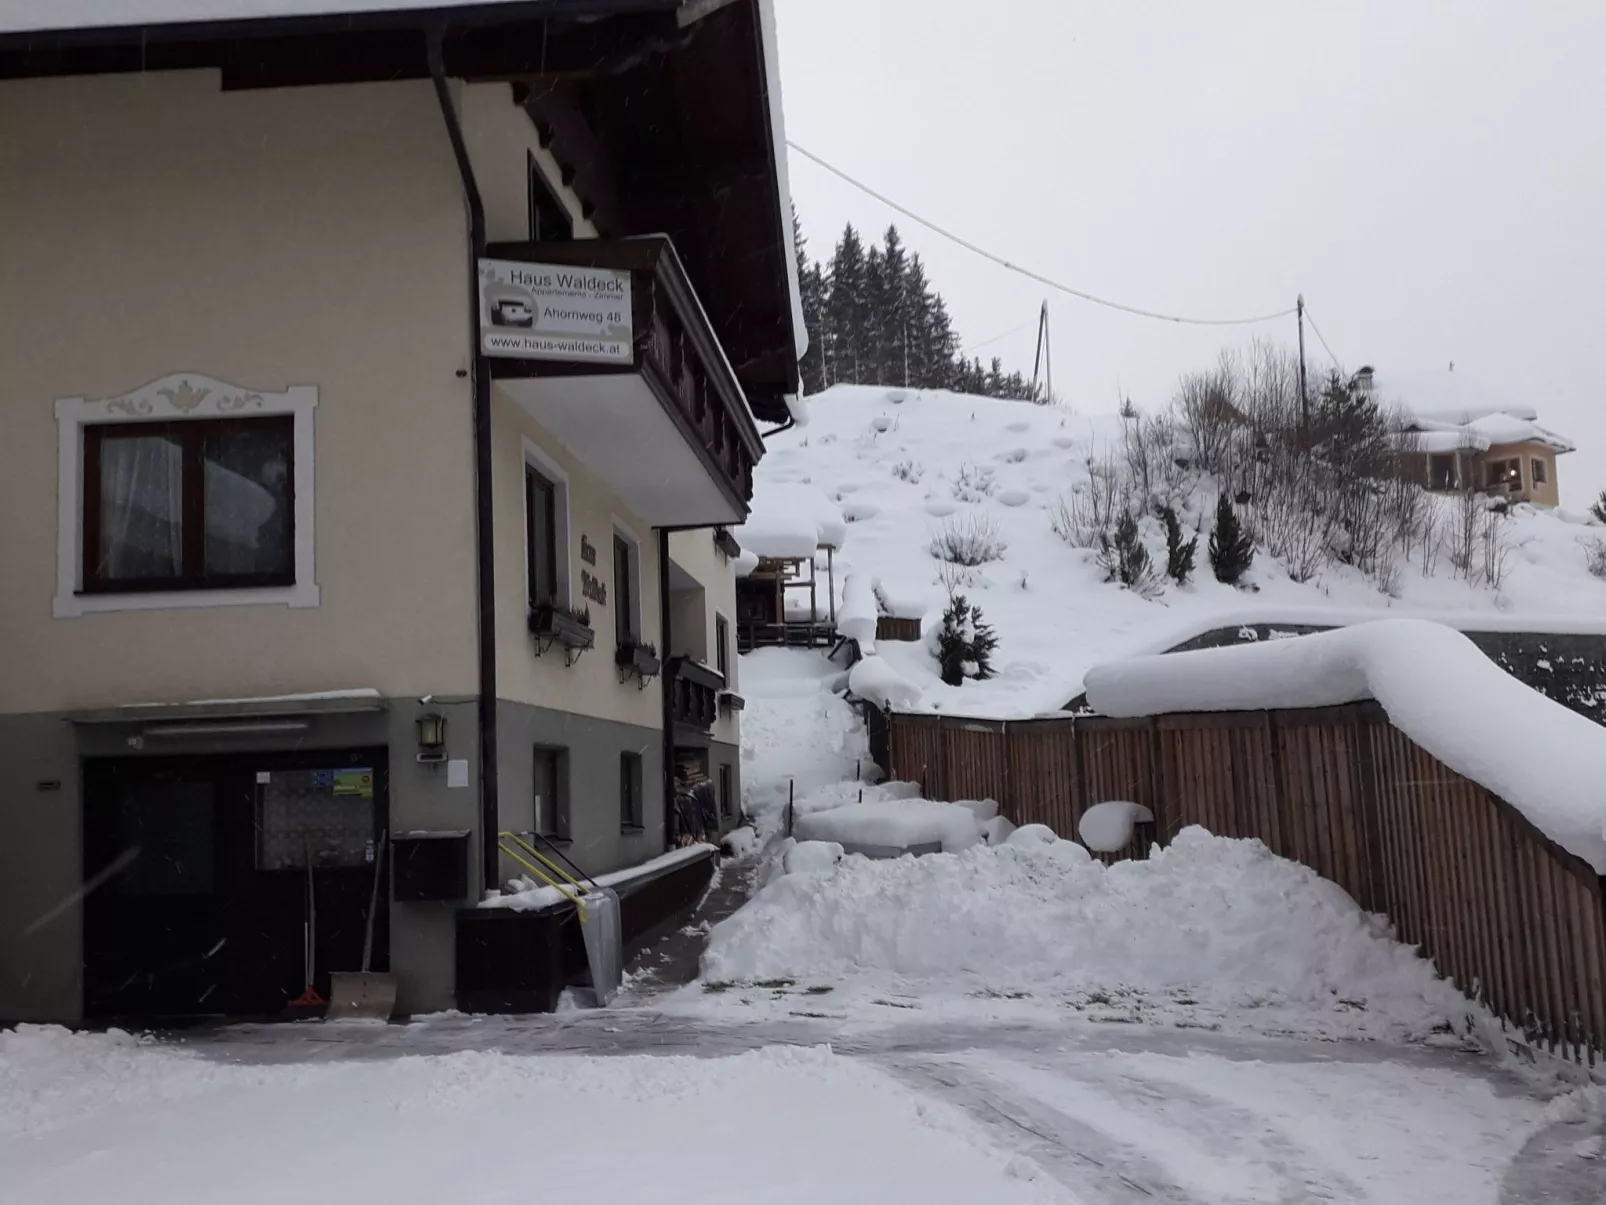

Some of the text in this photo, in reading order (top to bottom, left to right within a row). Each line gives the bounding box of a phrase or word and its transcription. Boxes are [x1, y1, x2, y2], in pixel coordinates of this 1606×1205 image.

[511, 270, 624, 293] Haus Waldeck
[594, 290, 623, 300] Zimmer
[544, 307, 603, 323] Ahornweg
[491, 337, 620, 354] www.haus-waldeck.at
